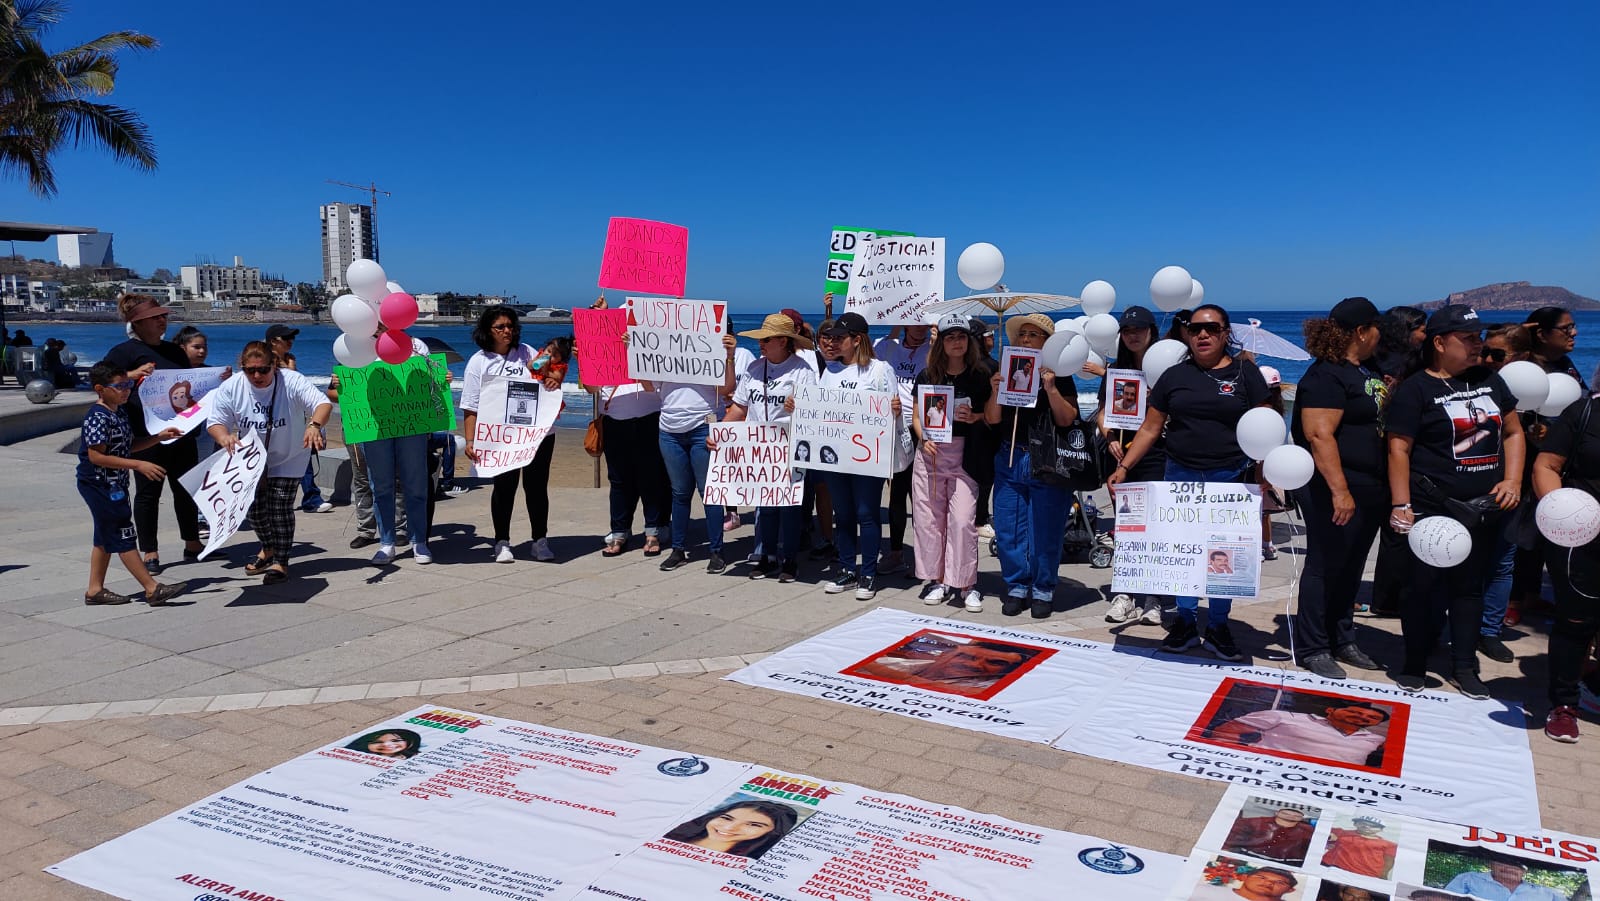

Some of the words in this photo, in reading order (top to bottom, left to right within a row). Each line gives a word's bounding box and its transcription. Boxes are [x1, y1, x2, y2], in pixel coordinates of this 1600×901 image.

[877, 263, 934, 275] Queremos
[633, 331, 659, 350] NO
[669, 334, 712, 353] MAS
[505, 366, 524, 377] Soy
[636, 353, 724, 378] IMPUNIDAD
[897, 362, 916, 374] Soy
[819, 387, 863, 406] JUSTICIA
[869, 395, 890, 417] NO
[824, 410, 855, 421] MADRE
[862, 415, 887, 427] PERO
[380, 420, 431, 438] TUYAS
[712, 426, 737, 443] DOS
[748, 425, 789, 443] HIJA
[795, 424, 815, 436] MIS
[818, 425, 850, 441] HIJAS
[712, 447, 721, 464] Y
[725, 445, 745, 464] UNA
[711, 466, 804, 483] SEPARADAS
[705, 486, 728, 505] POR
[737, 487, 754, 505] SU
[760, 486, 801, 505] PADRE
[1170, 482, 1205, 494] 2019
[1176, 495, 1190, 503] NO
[1195, 495, 1207, 504] SE
[1210, 494, 1252, 503] OLVIDA
[1173, 544, 1203, 554] MESES
[936, 621, 982, 631] VAMOS
[1231, 667, 1296, 680] VAMOS
[768, 673, 858, 693] Ernesto
[865, 691, 889, 700] M.
[901, 698, 1025, 726] González
[821, 691, 932, 718] Chiquete
[404, 717, 469, 734] SINALOA
[415, 712, 482, 729] AMBER
[505, 725, 585, 744] COMUNICADO
[586, 737, 642, 754] URGENTE
[760, 771, 819, 789] ALERTA
[1168, 752, 1271, 775] Oscar
[1281, 773, 1402, 802] Osuna
[1287, 764, 1308, 772] de
[1313, 769, 1371, 783] agosto
[1378, 780, 1405, 789] del
[1410, 788, 1455, 798] 2020
[474, 787, 507, 798] COLOR
[739, 783, 821, 806] SINALOA
[747, 776, 828, 800] AMBER
[512, 789, 553, 803] MECHAS
[554, 798, 587, 811] COLOR
[588, 806, 617, 817] ROSA.
[855, 800, 902, 813] Reporte
[861, 795, 966, 822] COMUNICADO
[969, 818, 1046, 840] URGENTE
[888, 813, 922, 824] Fecha
[866, 821, 906, 835] hechos:
[800, 823, 872, 845] Nacionalidad:
[873, 841, 940, 860] MEXICANA.
[824, 836, 858, 849] actual:
[870, 847, 883, 855] 14
[884, 851, 922, 864] AÑOS.
[842, 822, 857, 830] de
[858, 827, 899, 840] hechos:
[902, 836, 969, 856] MAZATLÁN,
[972, 851, 1032, 870] SINALOA.
[293, 821, 332, 836] búsqueda
[356, 838, 385, 850] menor,
[387, 847, 413, 857] quien
[414, 853, 442, 864] desde
[485, 870, 498, 878] de
[500, 873, 555, 892] septiembre
[356, 830, 400, 845] noviembre
[402, 841, 414, 849] de
[451, 854, 509, 873] denunciante
[511, 870, 552, 883] autorizó
[554, 878, 563, 886] la
[709, 851, 748, 864] LUPITA
[783, 836, 848, 858] Complexión:
[850, 855, 910, 874] DELGADA.
[868, 853, 921, 871] METROS.
[321, 845, 362, 859] considera
[362, 855, 379, 865] que
[394, 863, 440, 880] integridad
[441, 876, 478, 890] pudiera
[479, 885, 542, 901] encontrarse
[711, 859, 748, 871] VALLE
[749, 864, 789, 879] Labios:
[769, 847, 812, 862] Cabello:
[823, 862, 865, 878] COLOR
[867, 874, 929, 895] CASTAÑO,
[830, 856, 887, 876] MORENO
[888, 872, 931, 887] CLARA.
[175, 873, 235, 895] ALERTA
[396, 872, 409, 880] de
[742, 870, 775, 884] Nariz:
[798, 886, 838, 901] CHICA.
[755, 859, 787, 870] Boca:
[812, 873, 873, 896] MEDIANA.
[762, 852, 791, 864] Ojos:
[819, 868, 889, 892] MEDIANOS,
[892, 888, 937, 901] COLOR
[727, 878, 763, 894] Señas
